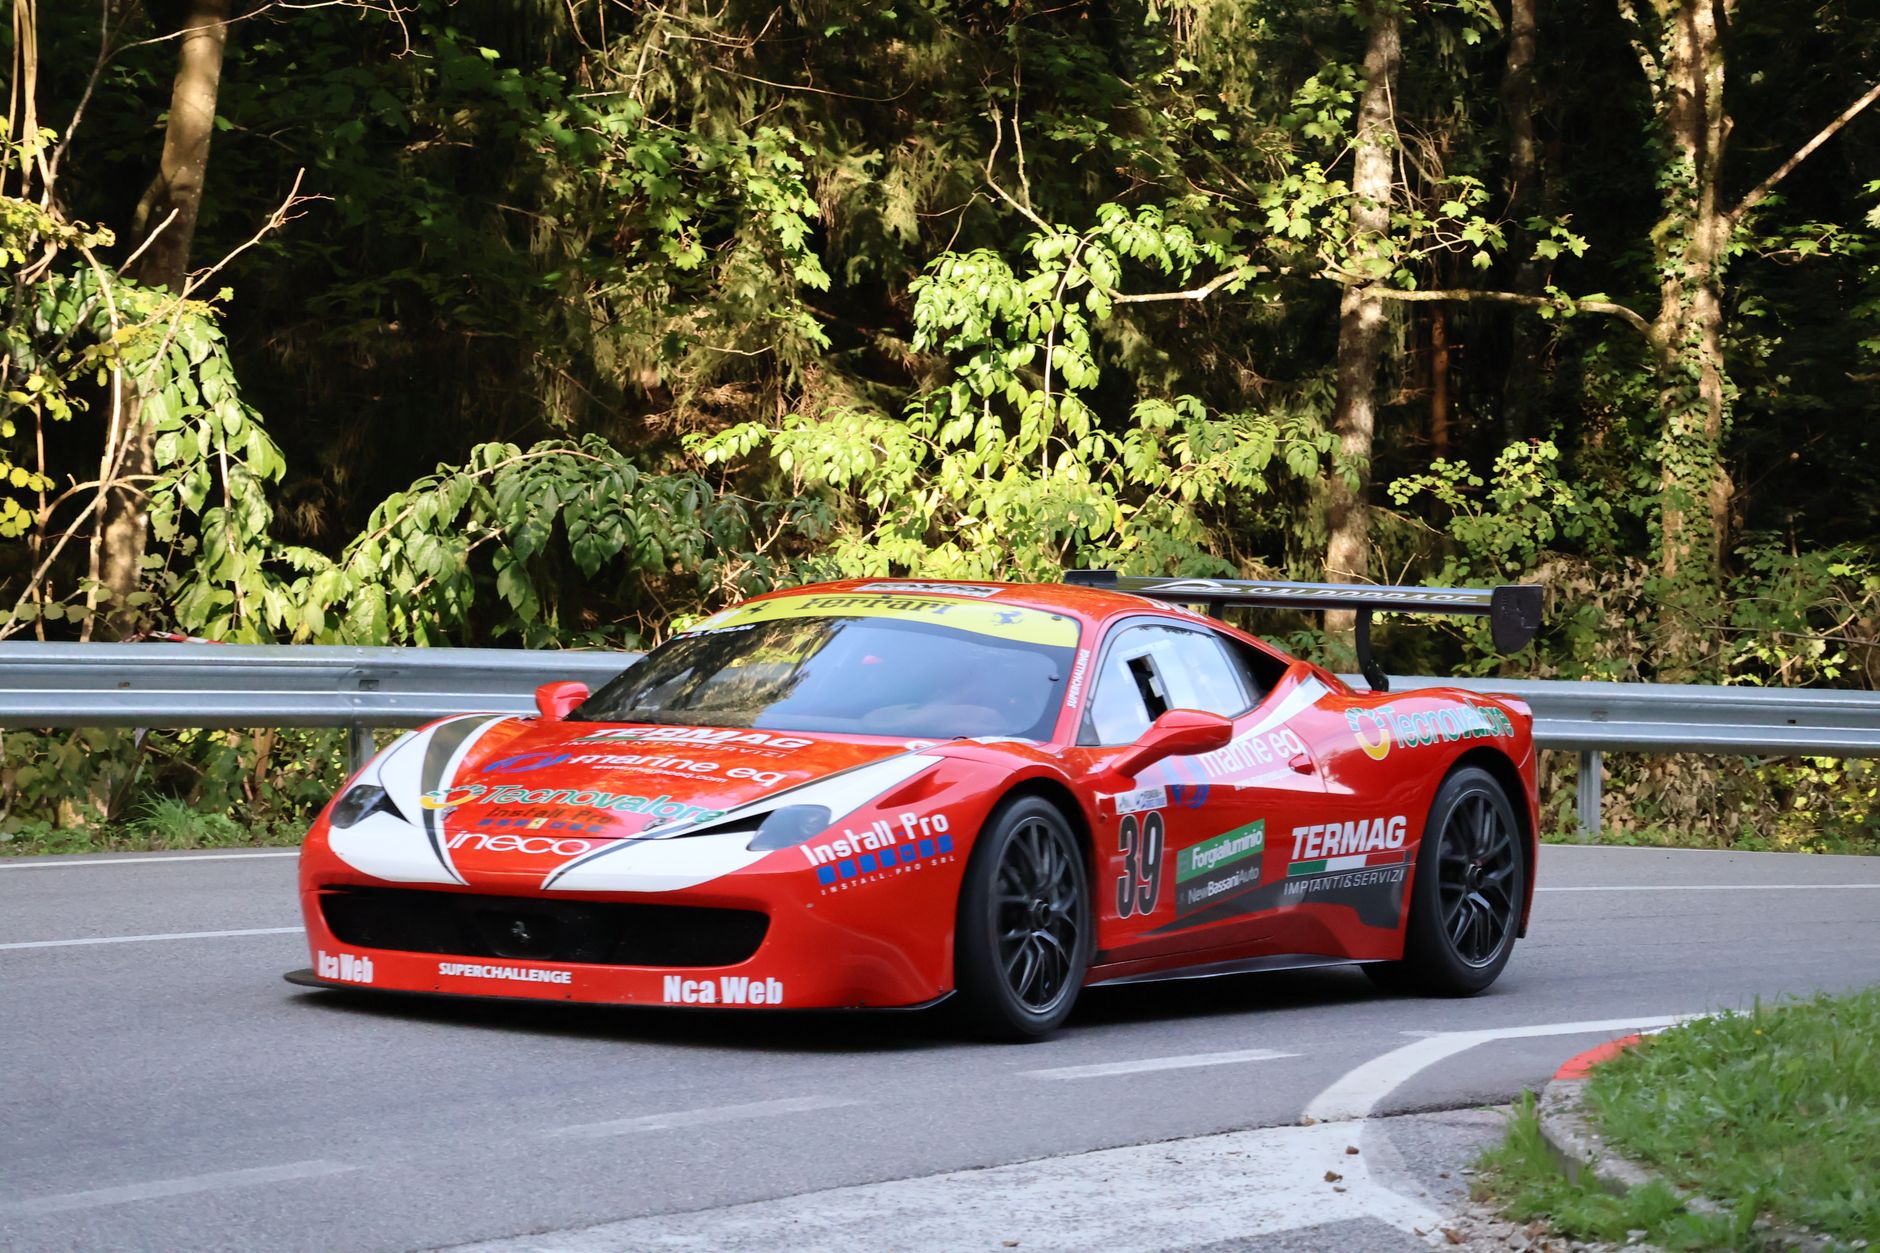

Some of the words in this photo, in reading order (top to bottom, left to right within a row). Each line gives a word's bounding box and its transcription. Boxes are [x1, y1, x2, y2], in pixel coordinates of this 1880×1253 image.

[795, 596, 957, 615] Ferrari
[1066, 648, 1091, 709] SUPERCHALLENGE
[587, 727, 815, 749] TERMAG
[568, 753, 720, 773] marine
[726, 766, 788, 787] eq
[478, 784, 727, 823] Tecnovalore
[486, 806, 567, 818] Install
[570, 810, 615, 824] Pro
[446, 830, 592, 856] ineco
[800, 819, 897, 867] Install
[898, 811, 949, 841] Pro
[1291, 815, 1407, 860] TERMAG
[1116, 810, 1165, 920] 39
[1283, 869, 1405, 896] IMPIANTI&SERVIZI
[339, 953, 374, 984] Web
[438, 962, 572, 984] SUPERCHALLENGE
[663, 975, 716, 1004] Nca
[719, 976, 784, 1005] Web
